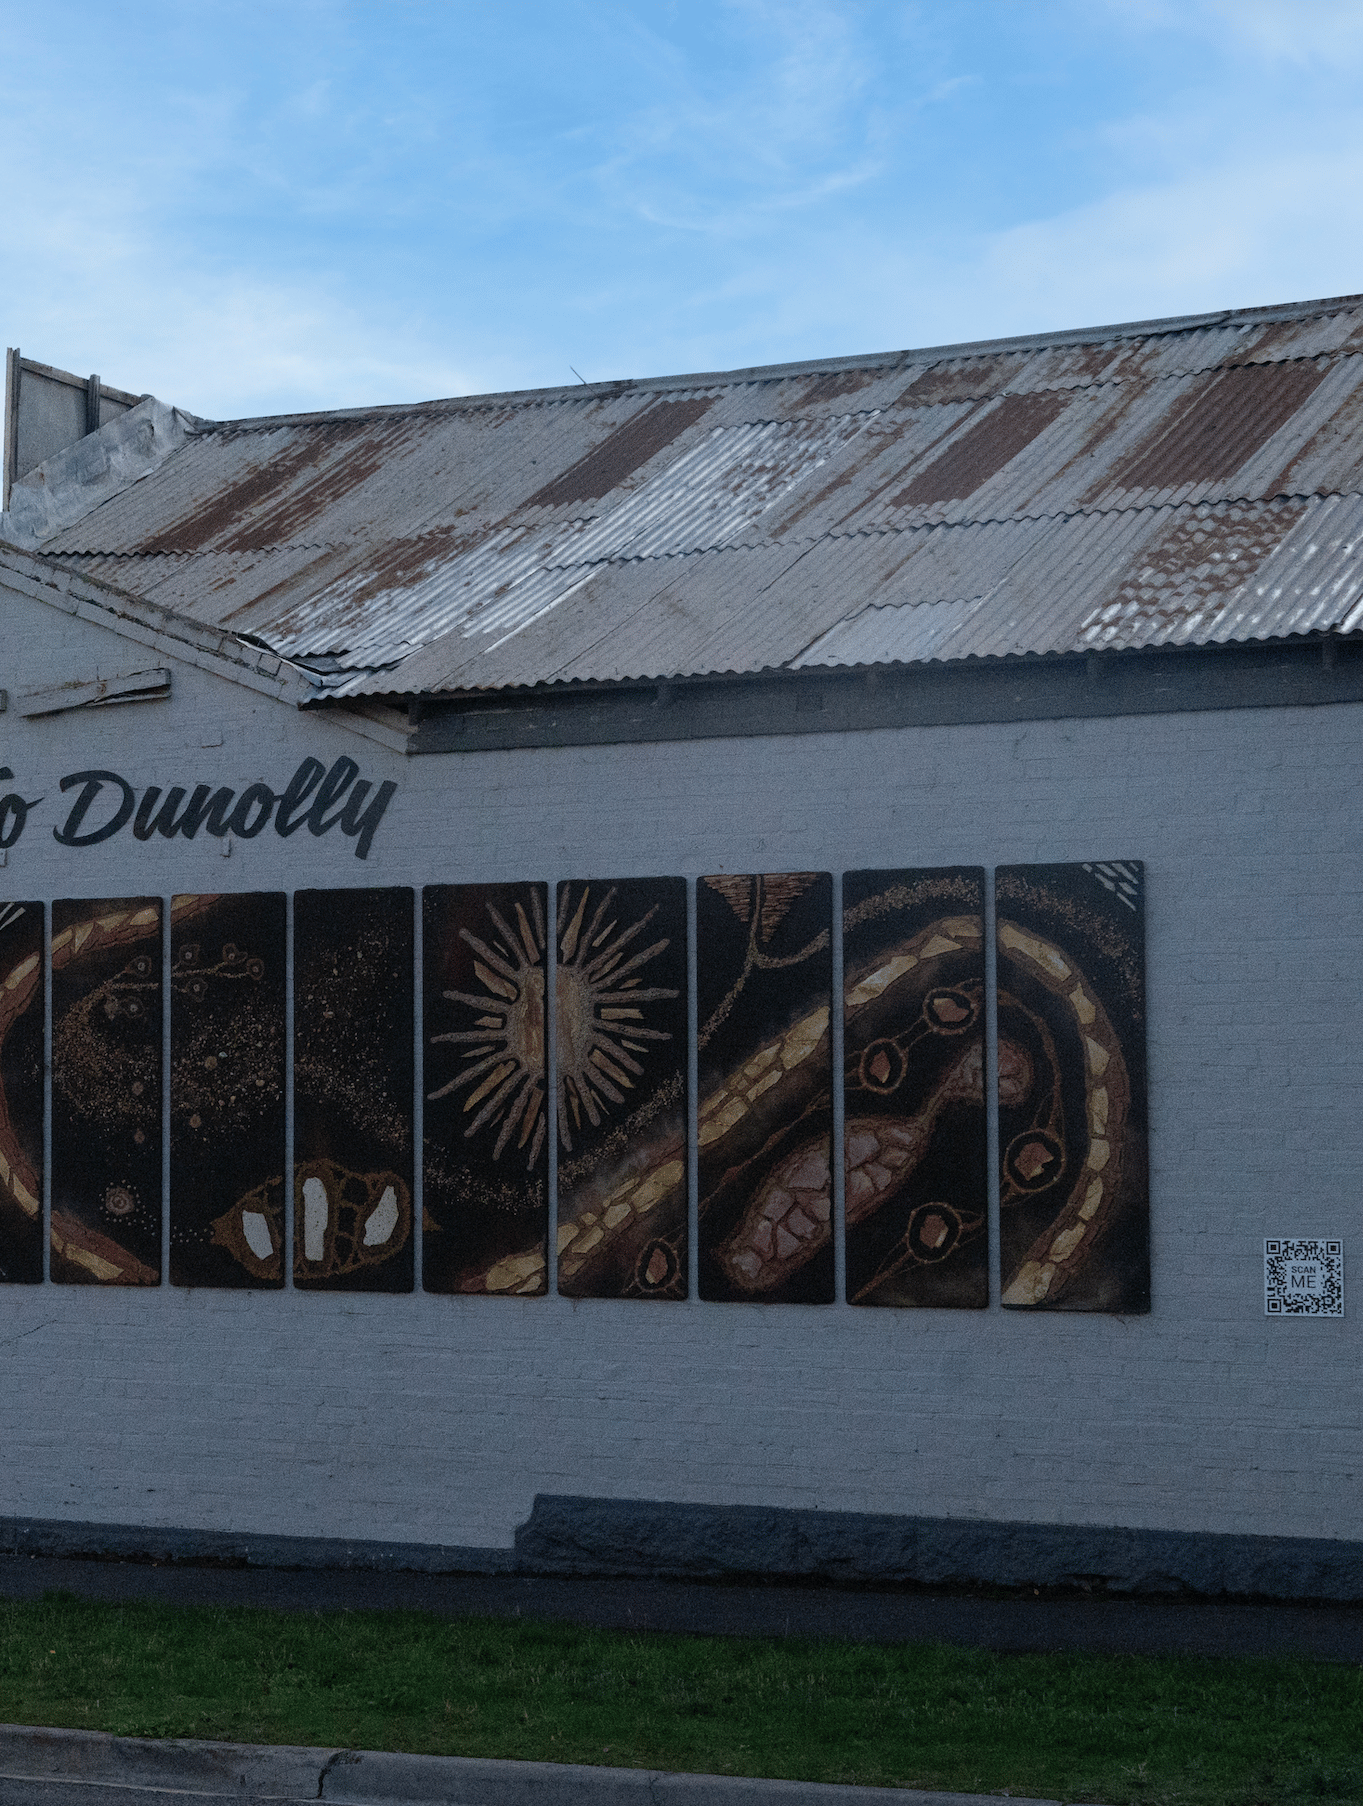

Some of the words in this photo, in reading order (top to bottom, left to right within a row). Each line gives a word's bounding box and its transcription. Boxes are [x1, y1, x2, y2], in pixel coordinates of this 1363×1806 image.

[52, 755, 398, 860] Dunolly
[1291, 1266, 1316, 1274] SCAN
[1291, 1275, 1316, 1288] ME
